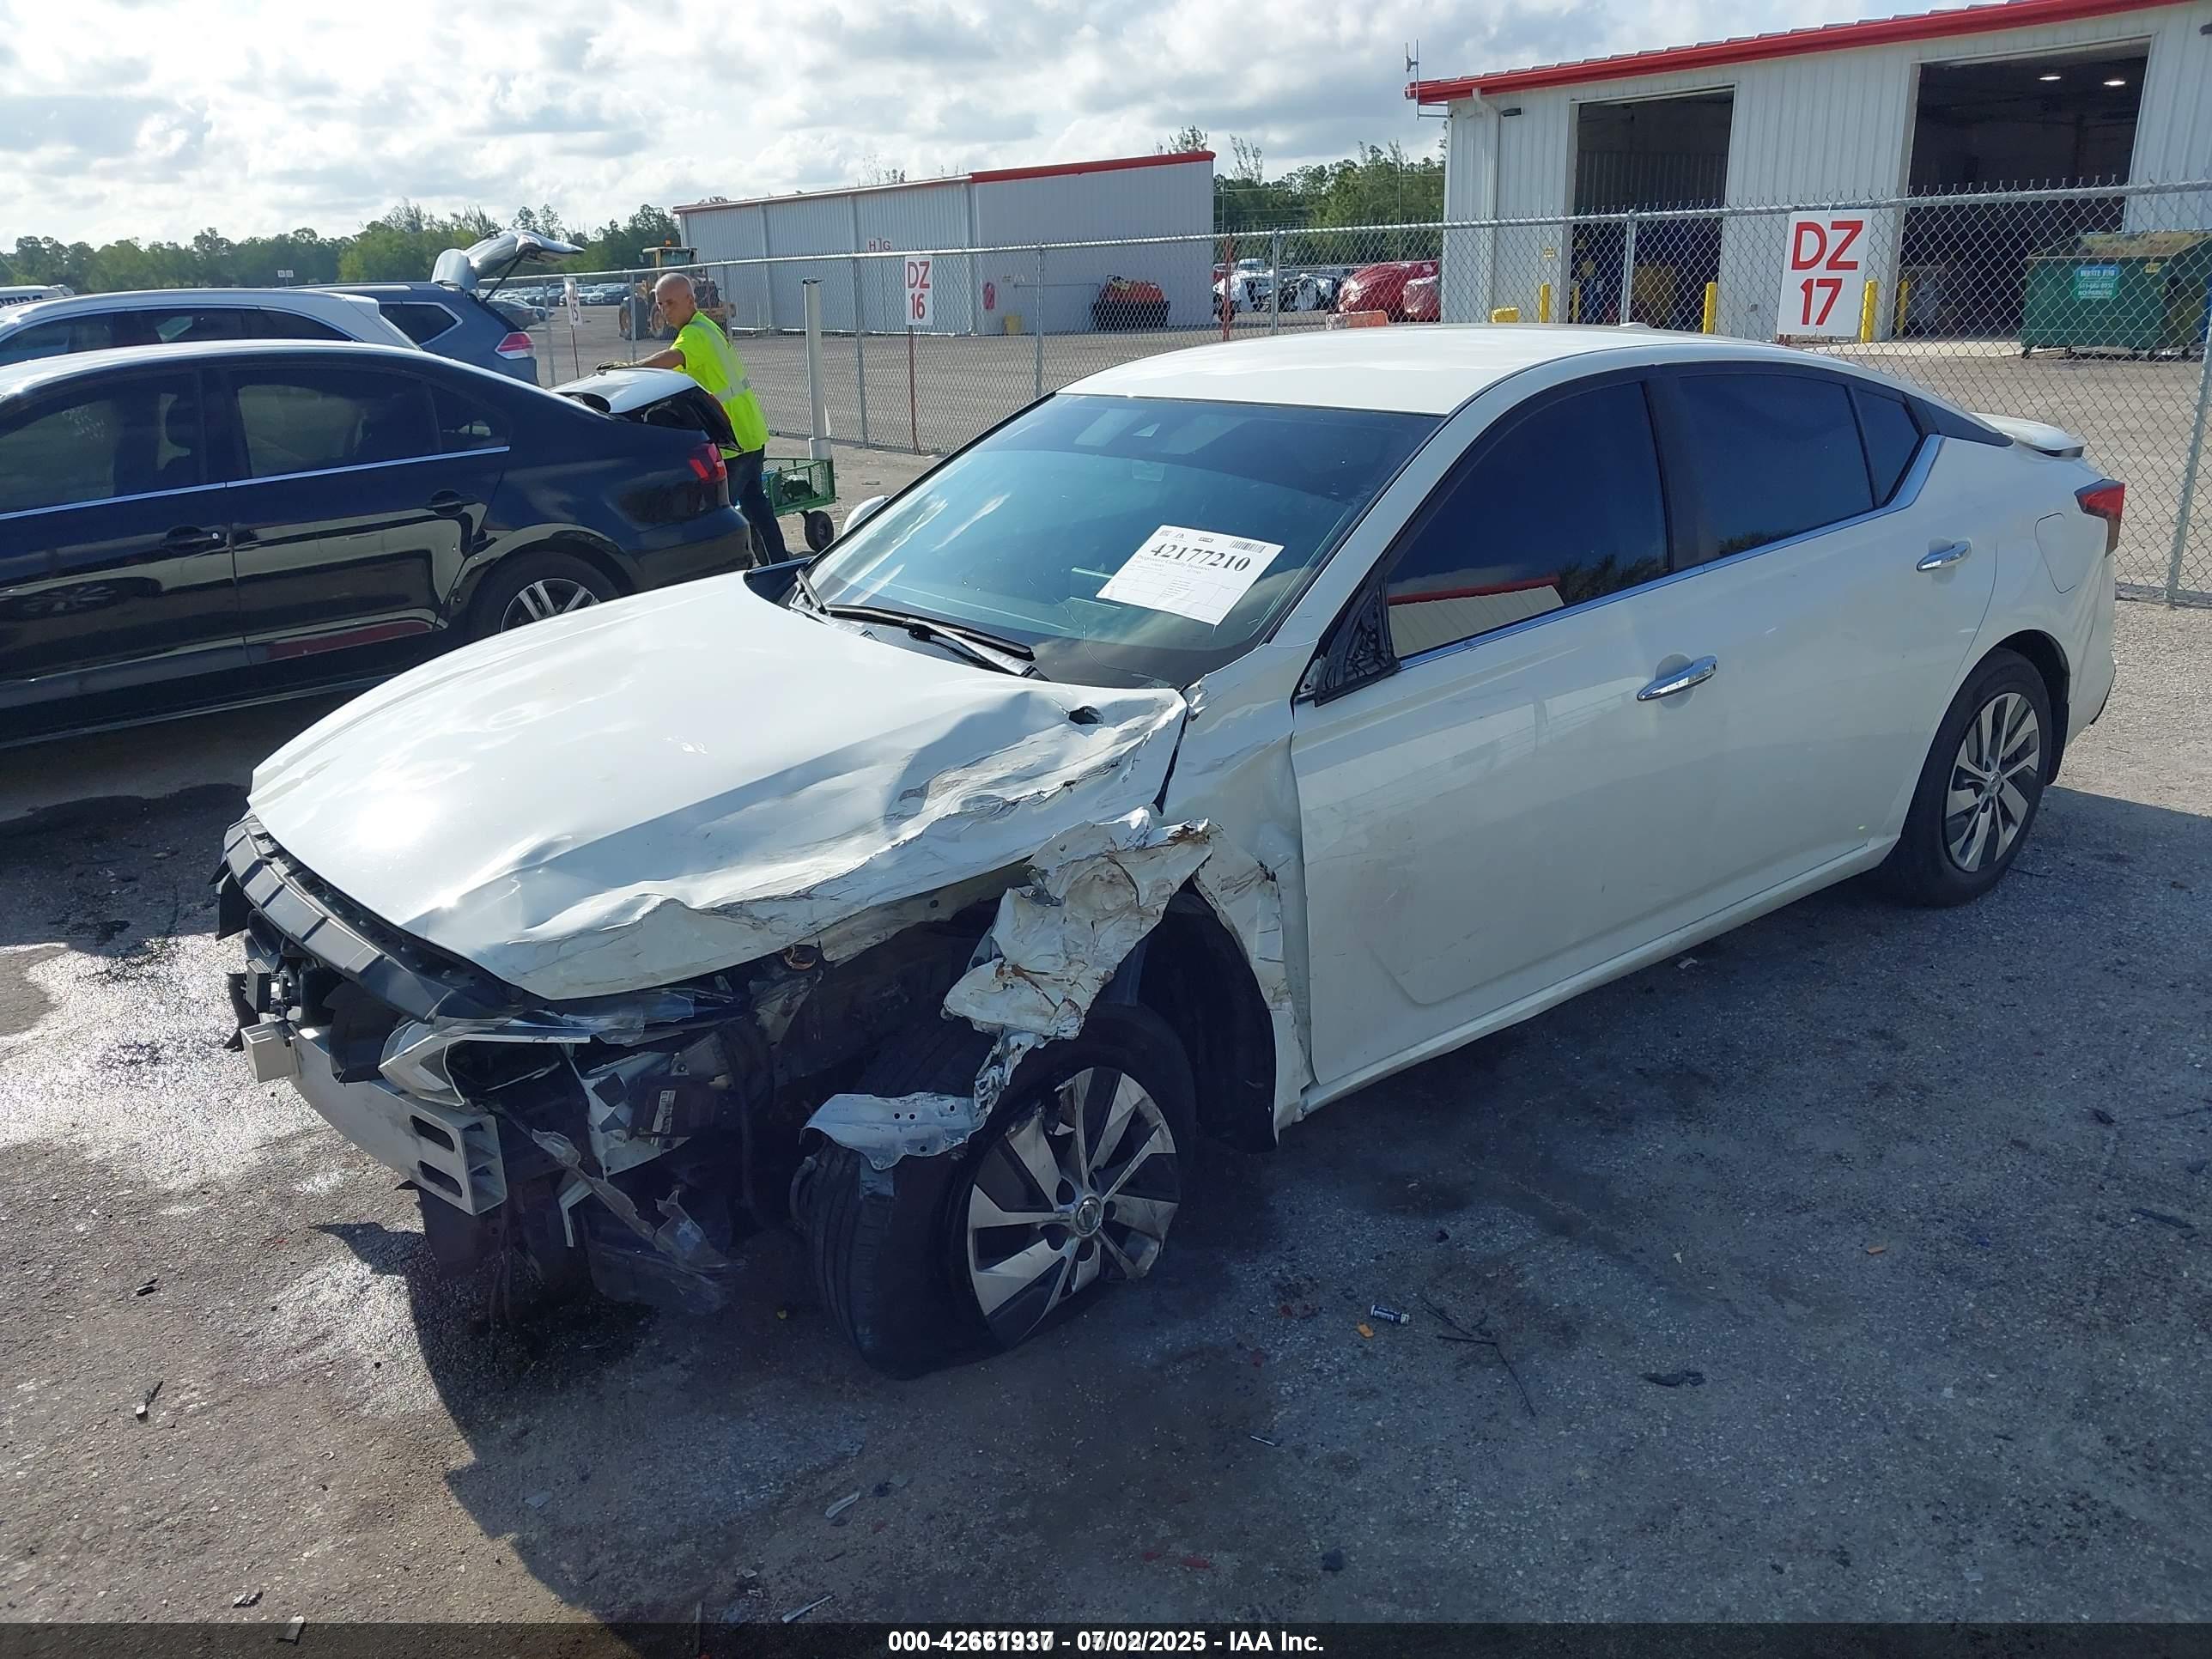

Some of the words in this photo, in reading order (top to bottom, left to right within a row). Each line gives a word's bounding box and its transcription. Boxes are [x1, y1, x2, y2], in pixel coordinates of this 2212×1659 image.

[1791, 220, 1863, 270] DZ
[908, 261, 930, 289] DZ
[910, 293, 926, 320] 16
[1800, 278, 1843, 325] 17
[1151, 543, 1251, 572] 42177210
